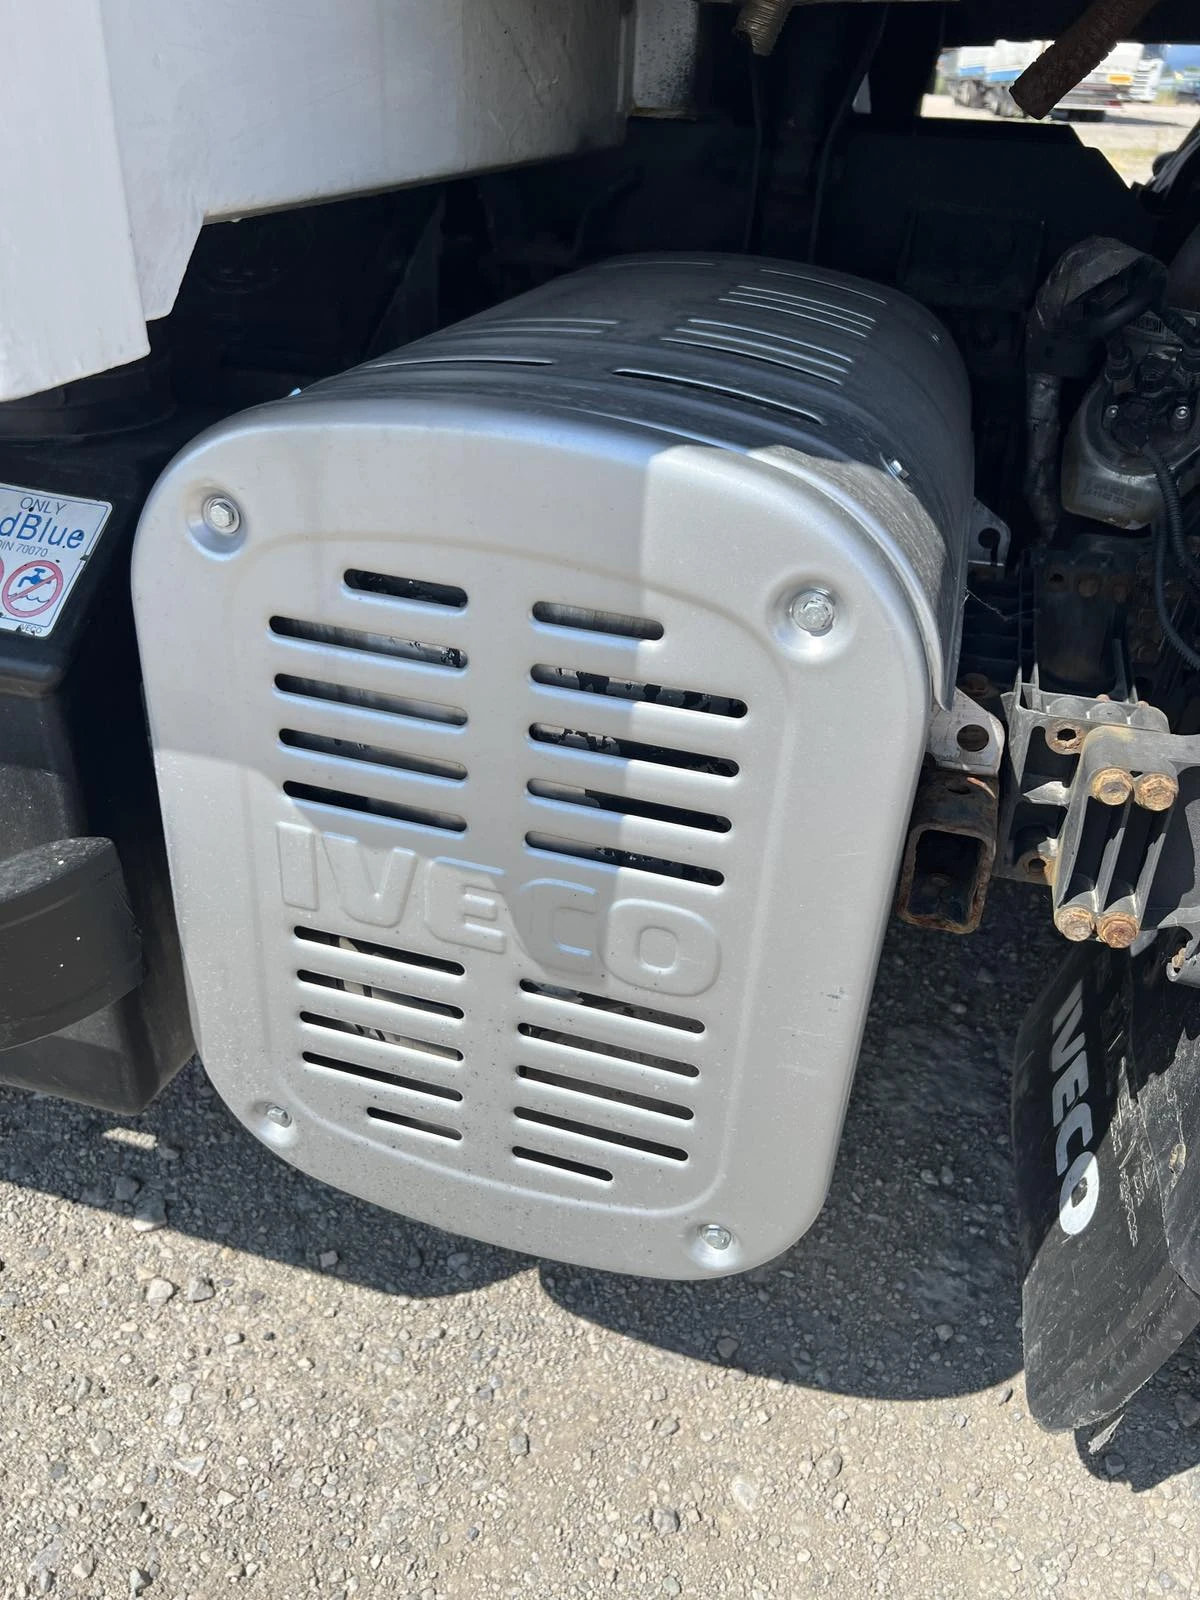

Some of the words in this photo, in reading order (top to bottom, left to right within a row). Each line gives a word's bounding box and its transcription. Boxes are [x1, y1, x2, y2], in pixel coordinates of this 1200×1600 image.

[16, 543, 49, 557] 70070
[20, 496, 67, 515] ONLY
[275, 820, 722, 997] IVECO
[1051, 979, 1100, 1235] IVECO
